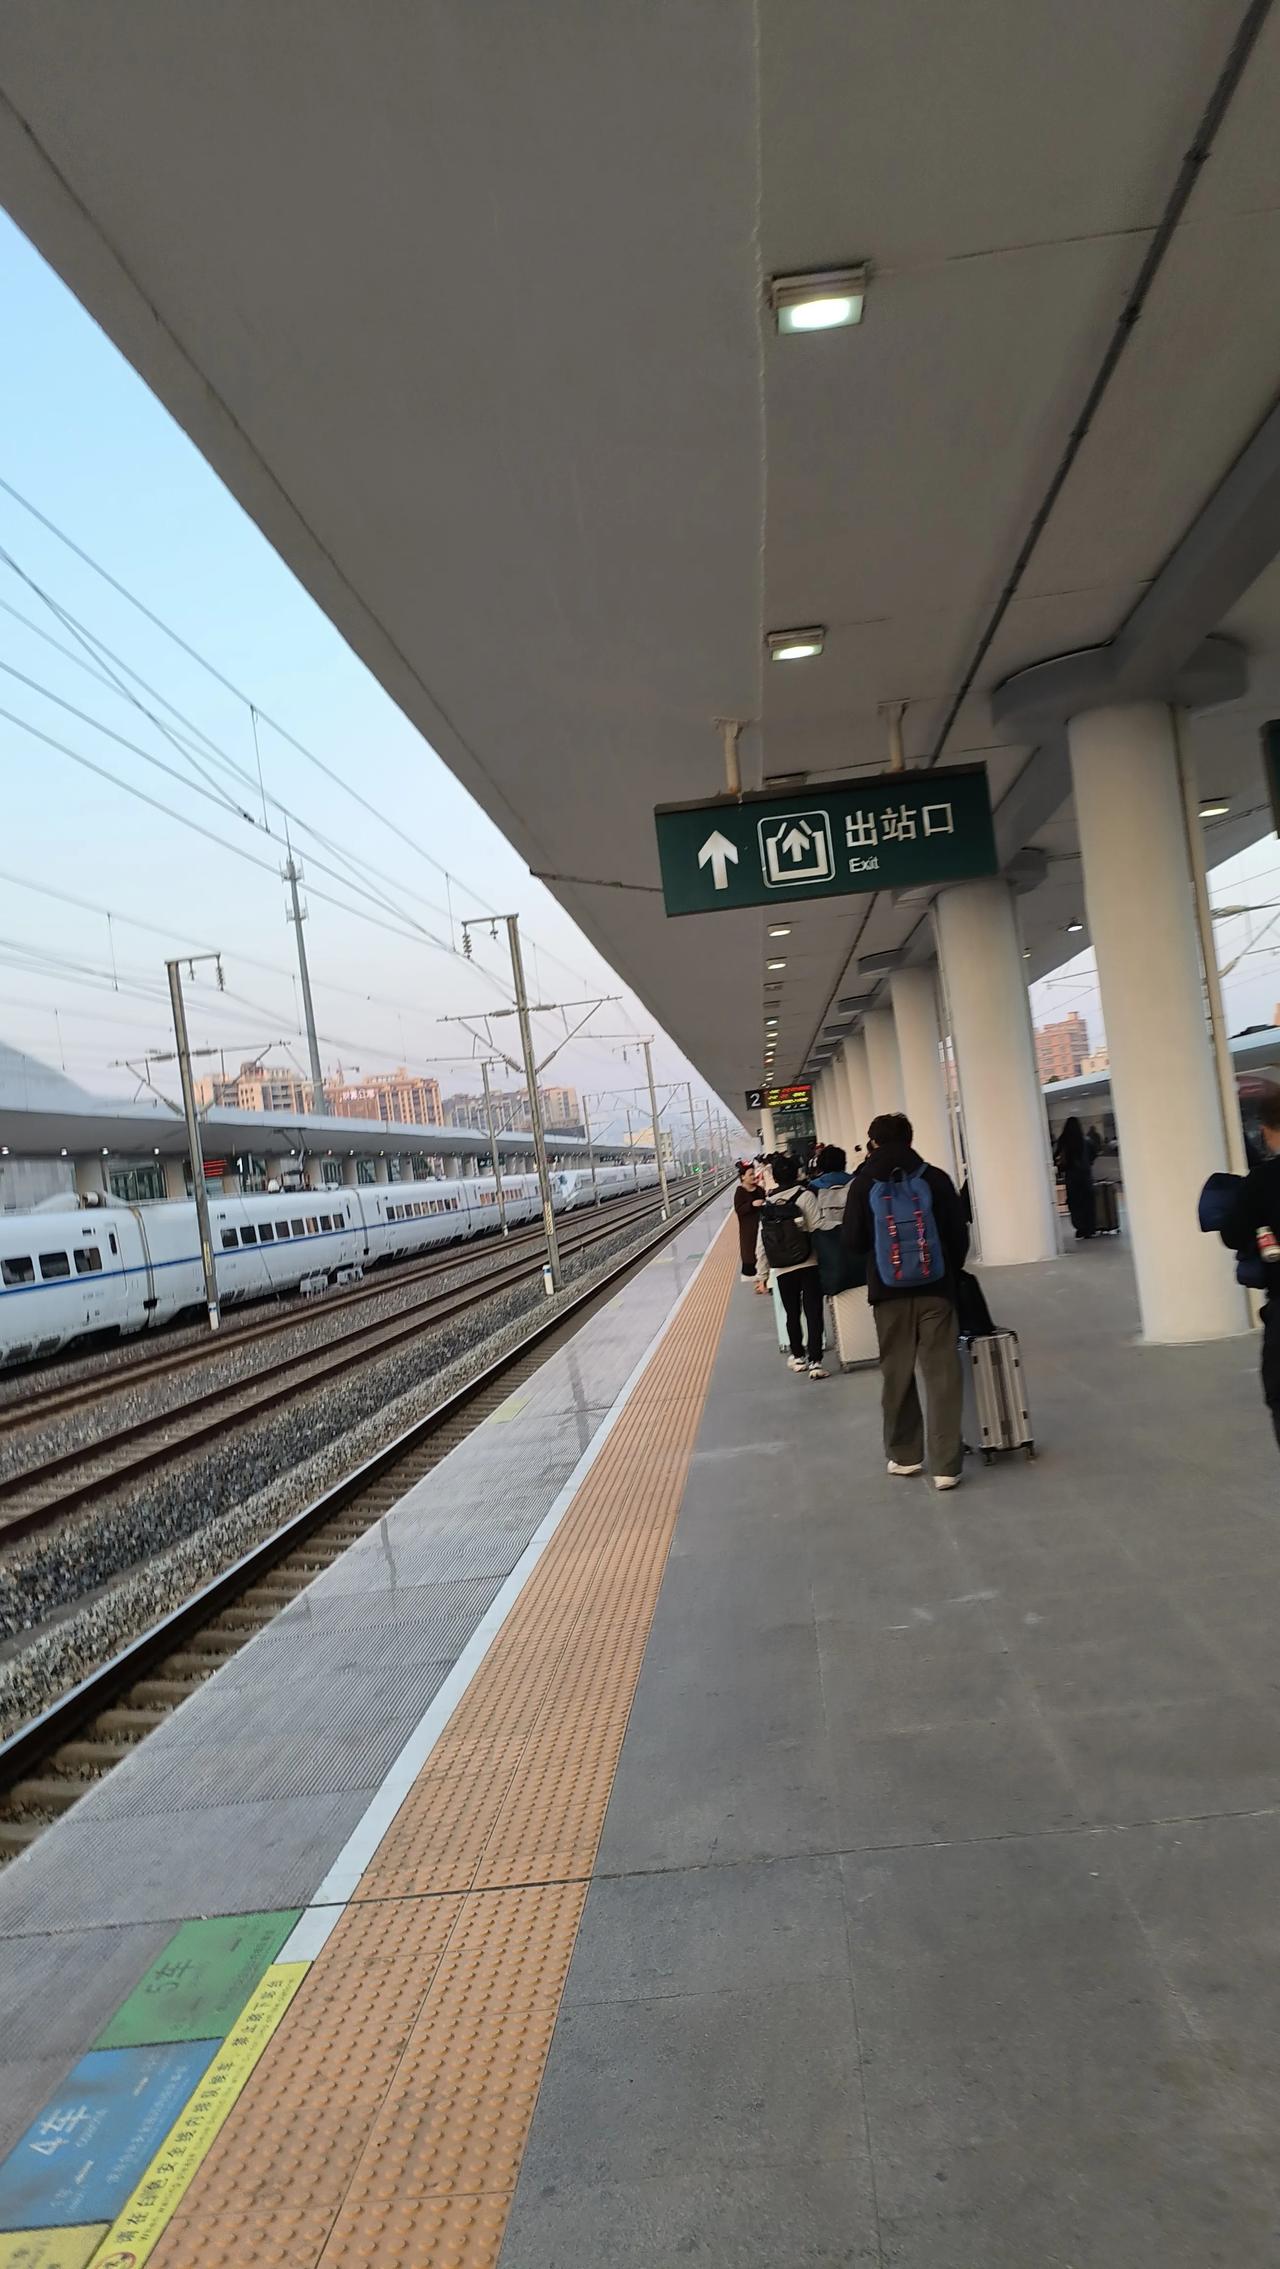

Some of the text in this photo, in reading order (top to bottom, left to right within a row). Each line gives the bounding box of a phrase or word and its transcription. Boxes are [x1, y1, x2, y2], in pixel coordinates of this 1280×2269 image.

[845, 803, 954, 848] 出站口
[849, 855, 880, 873] Exit
[750, 1093, 761, 1107] 2
[146, 1958, 195, 1995] 5车
[29, 2105, 88, 2155] 4车
